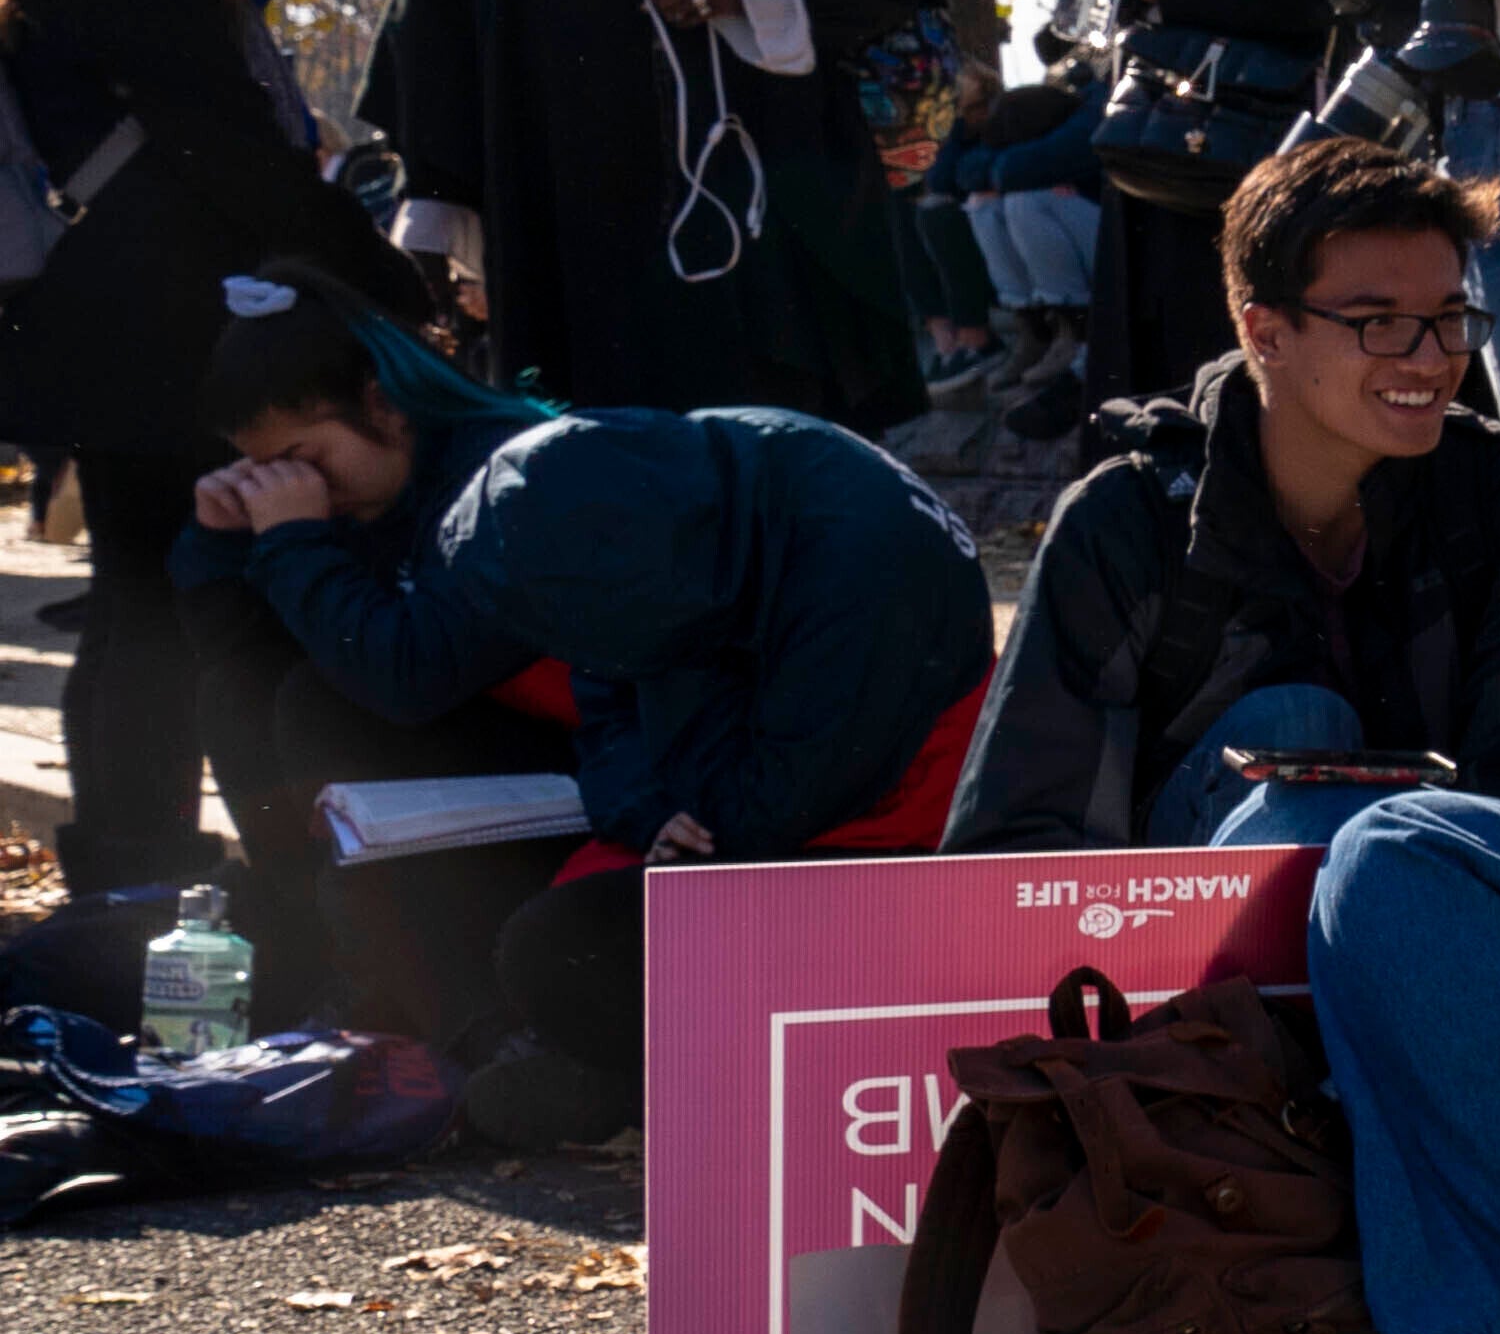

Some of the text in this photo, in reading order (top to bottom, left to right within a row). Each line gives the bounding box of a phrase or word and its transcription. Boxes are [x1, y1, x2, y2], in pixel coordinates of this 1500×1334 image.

[1016, 874, 1252, 908] MARCH FOR LIFE
[850, 1182, 918, 1248] N
